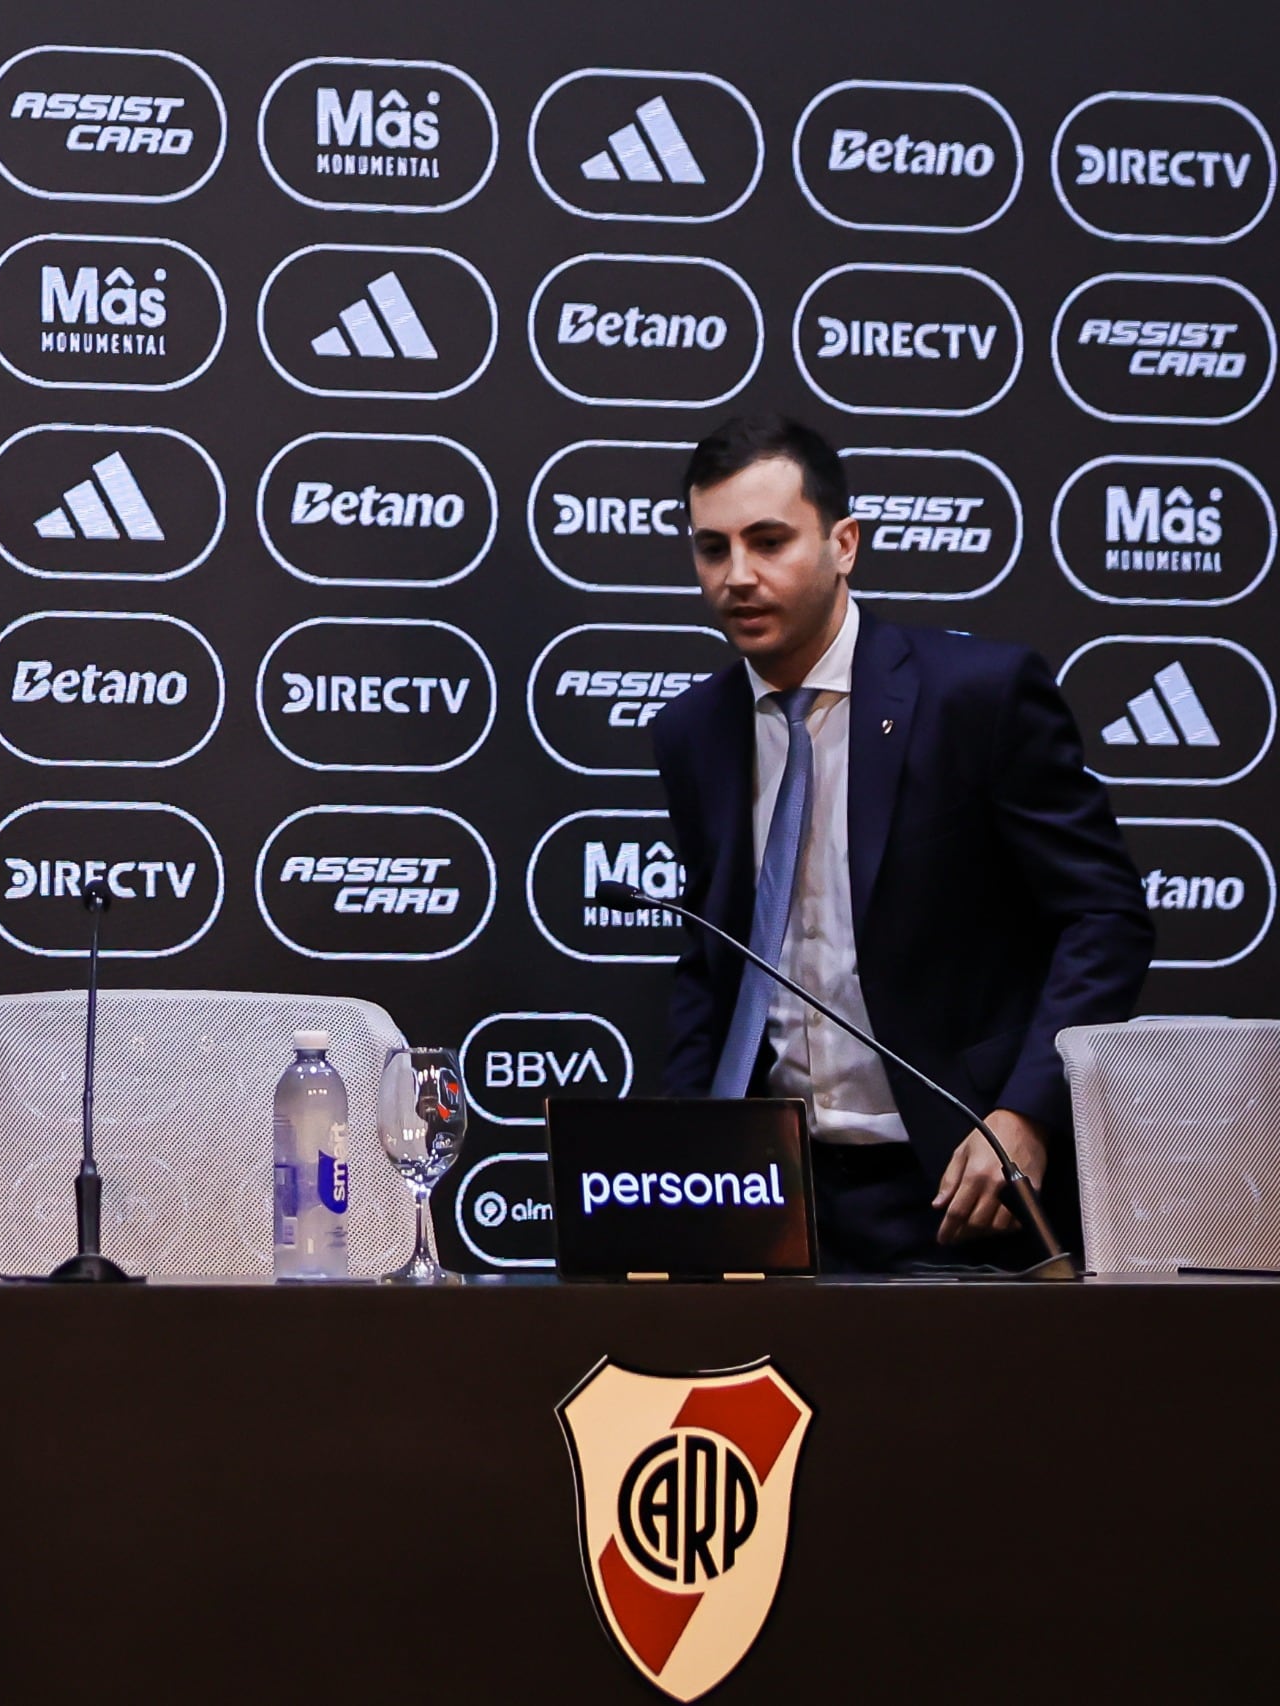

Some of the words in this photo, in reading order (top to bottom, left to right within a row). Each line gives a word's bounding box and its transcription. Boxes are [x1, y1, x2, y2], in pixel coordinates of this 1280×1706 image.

[11, 92, 184, 122] ASSIST
[66, 125, 193, 154] CARD
[829, 129, 994, 176] Betano
[317, 154, 439, 178] MONUMENTAL
[1076, 145, 1250, 187] DIRECTV
[558, 303, 727, 349] Betano
[818, 317, 996, 359] DIRECTV
[1079, 320, 1237, 348] ASSIST
[42, 332, 165, 355] MONUMENTAL
[1130, 351, 1246, 377] CARD
[292, 482, 464, 527] Betano
[553, 494, 692, 535] DIREC
[849, 495, 984, 523] SSIST
[872, 526, 991, 552] CARD
[1106, 550, 1221, 572] MONUMENTAL
[12, 660, 187, 704] Betano
[282, 673, 469, 713] DIRECTV
[609, 702, 666, 726] CA
[5, 858, 196, 899] DIRECTV
[280, 857, 450, 883] ASSIST
[334, 887, 459, 913] CARD
[1142, 870, 1243, 909] tano
[584, 906, 683, 927] MONUMEN
[487, 1048, 607, 1087] BBVA
[581, 1163, 785, 1214] personal
[512, 1199, 552, 1221] alm
